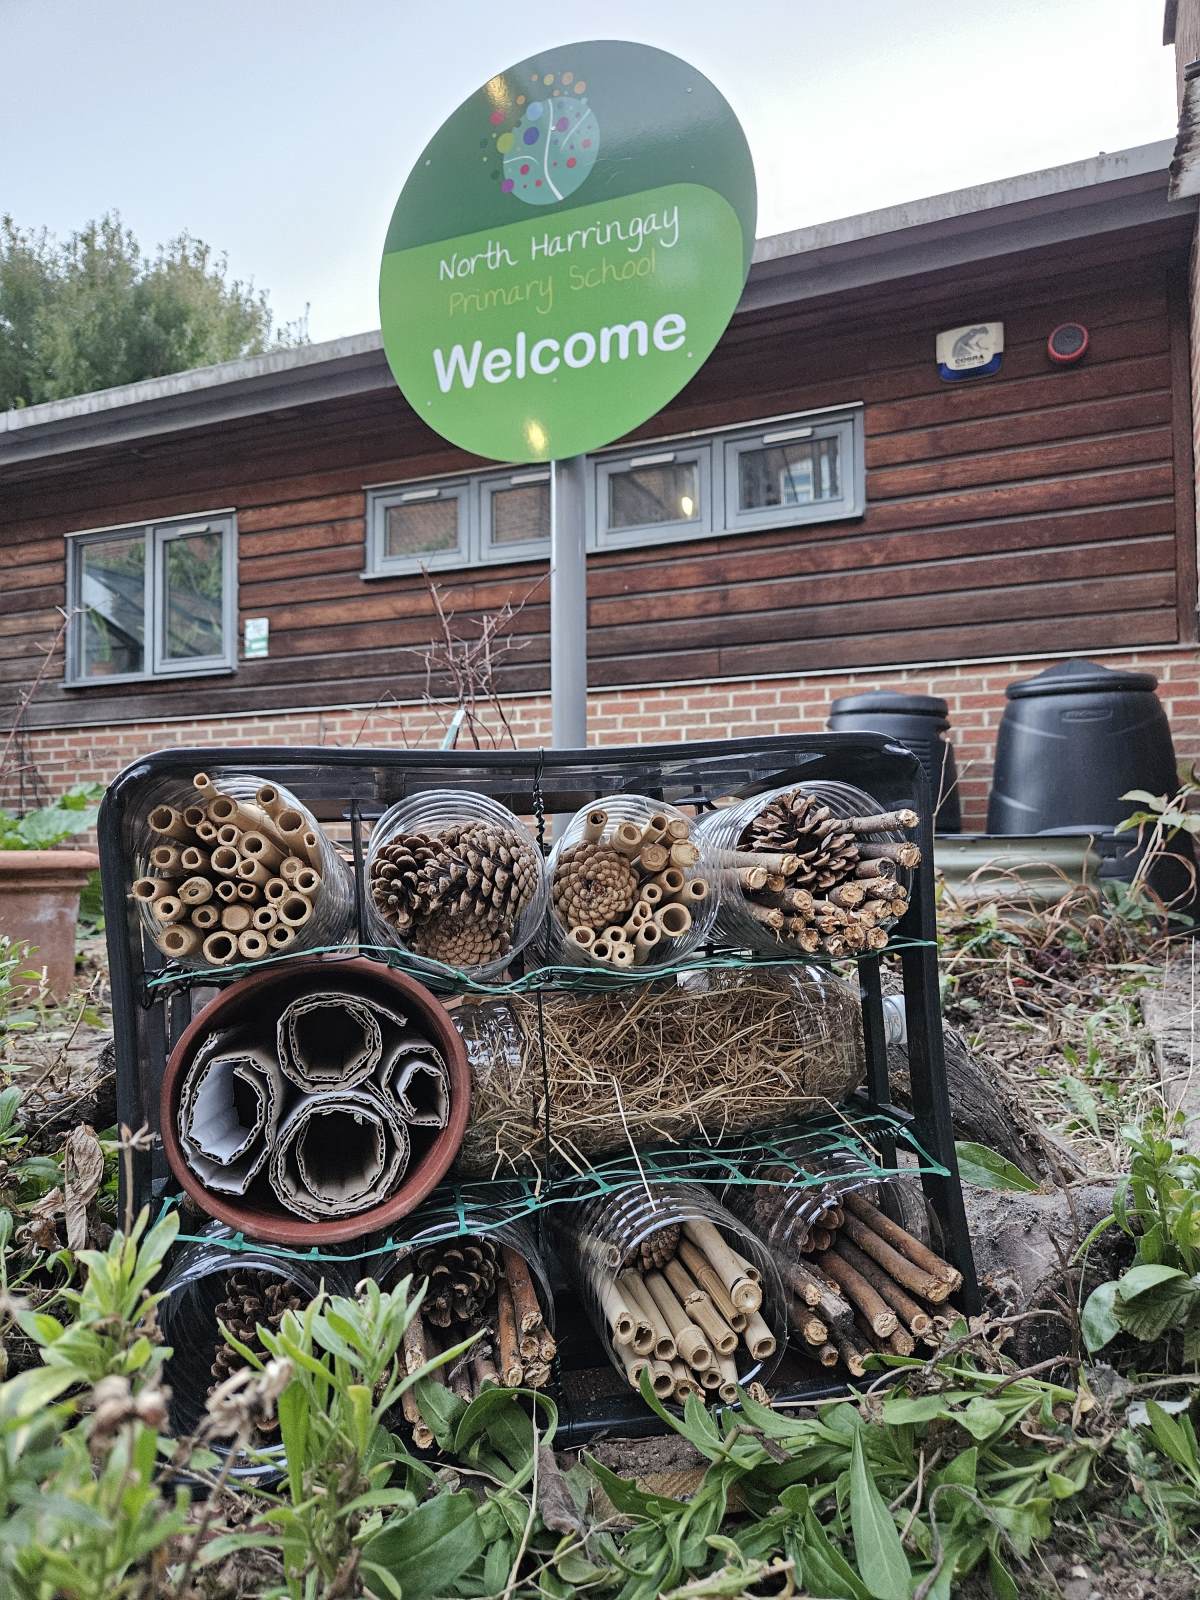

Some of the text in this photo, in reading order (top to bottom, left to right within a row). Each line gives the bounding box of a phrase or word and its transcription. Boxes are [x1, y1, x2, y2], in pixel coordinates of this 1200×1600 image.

[439, 205, 680, 281] North Harringay
[450, 248, 656, 315] Primary School
[432, 313, 687, 394] Welcome
